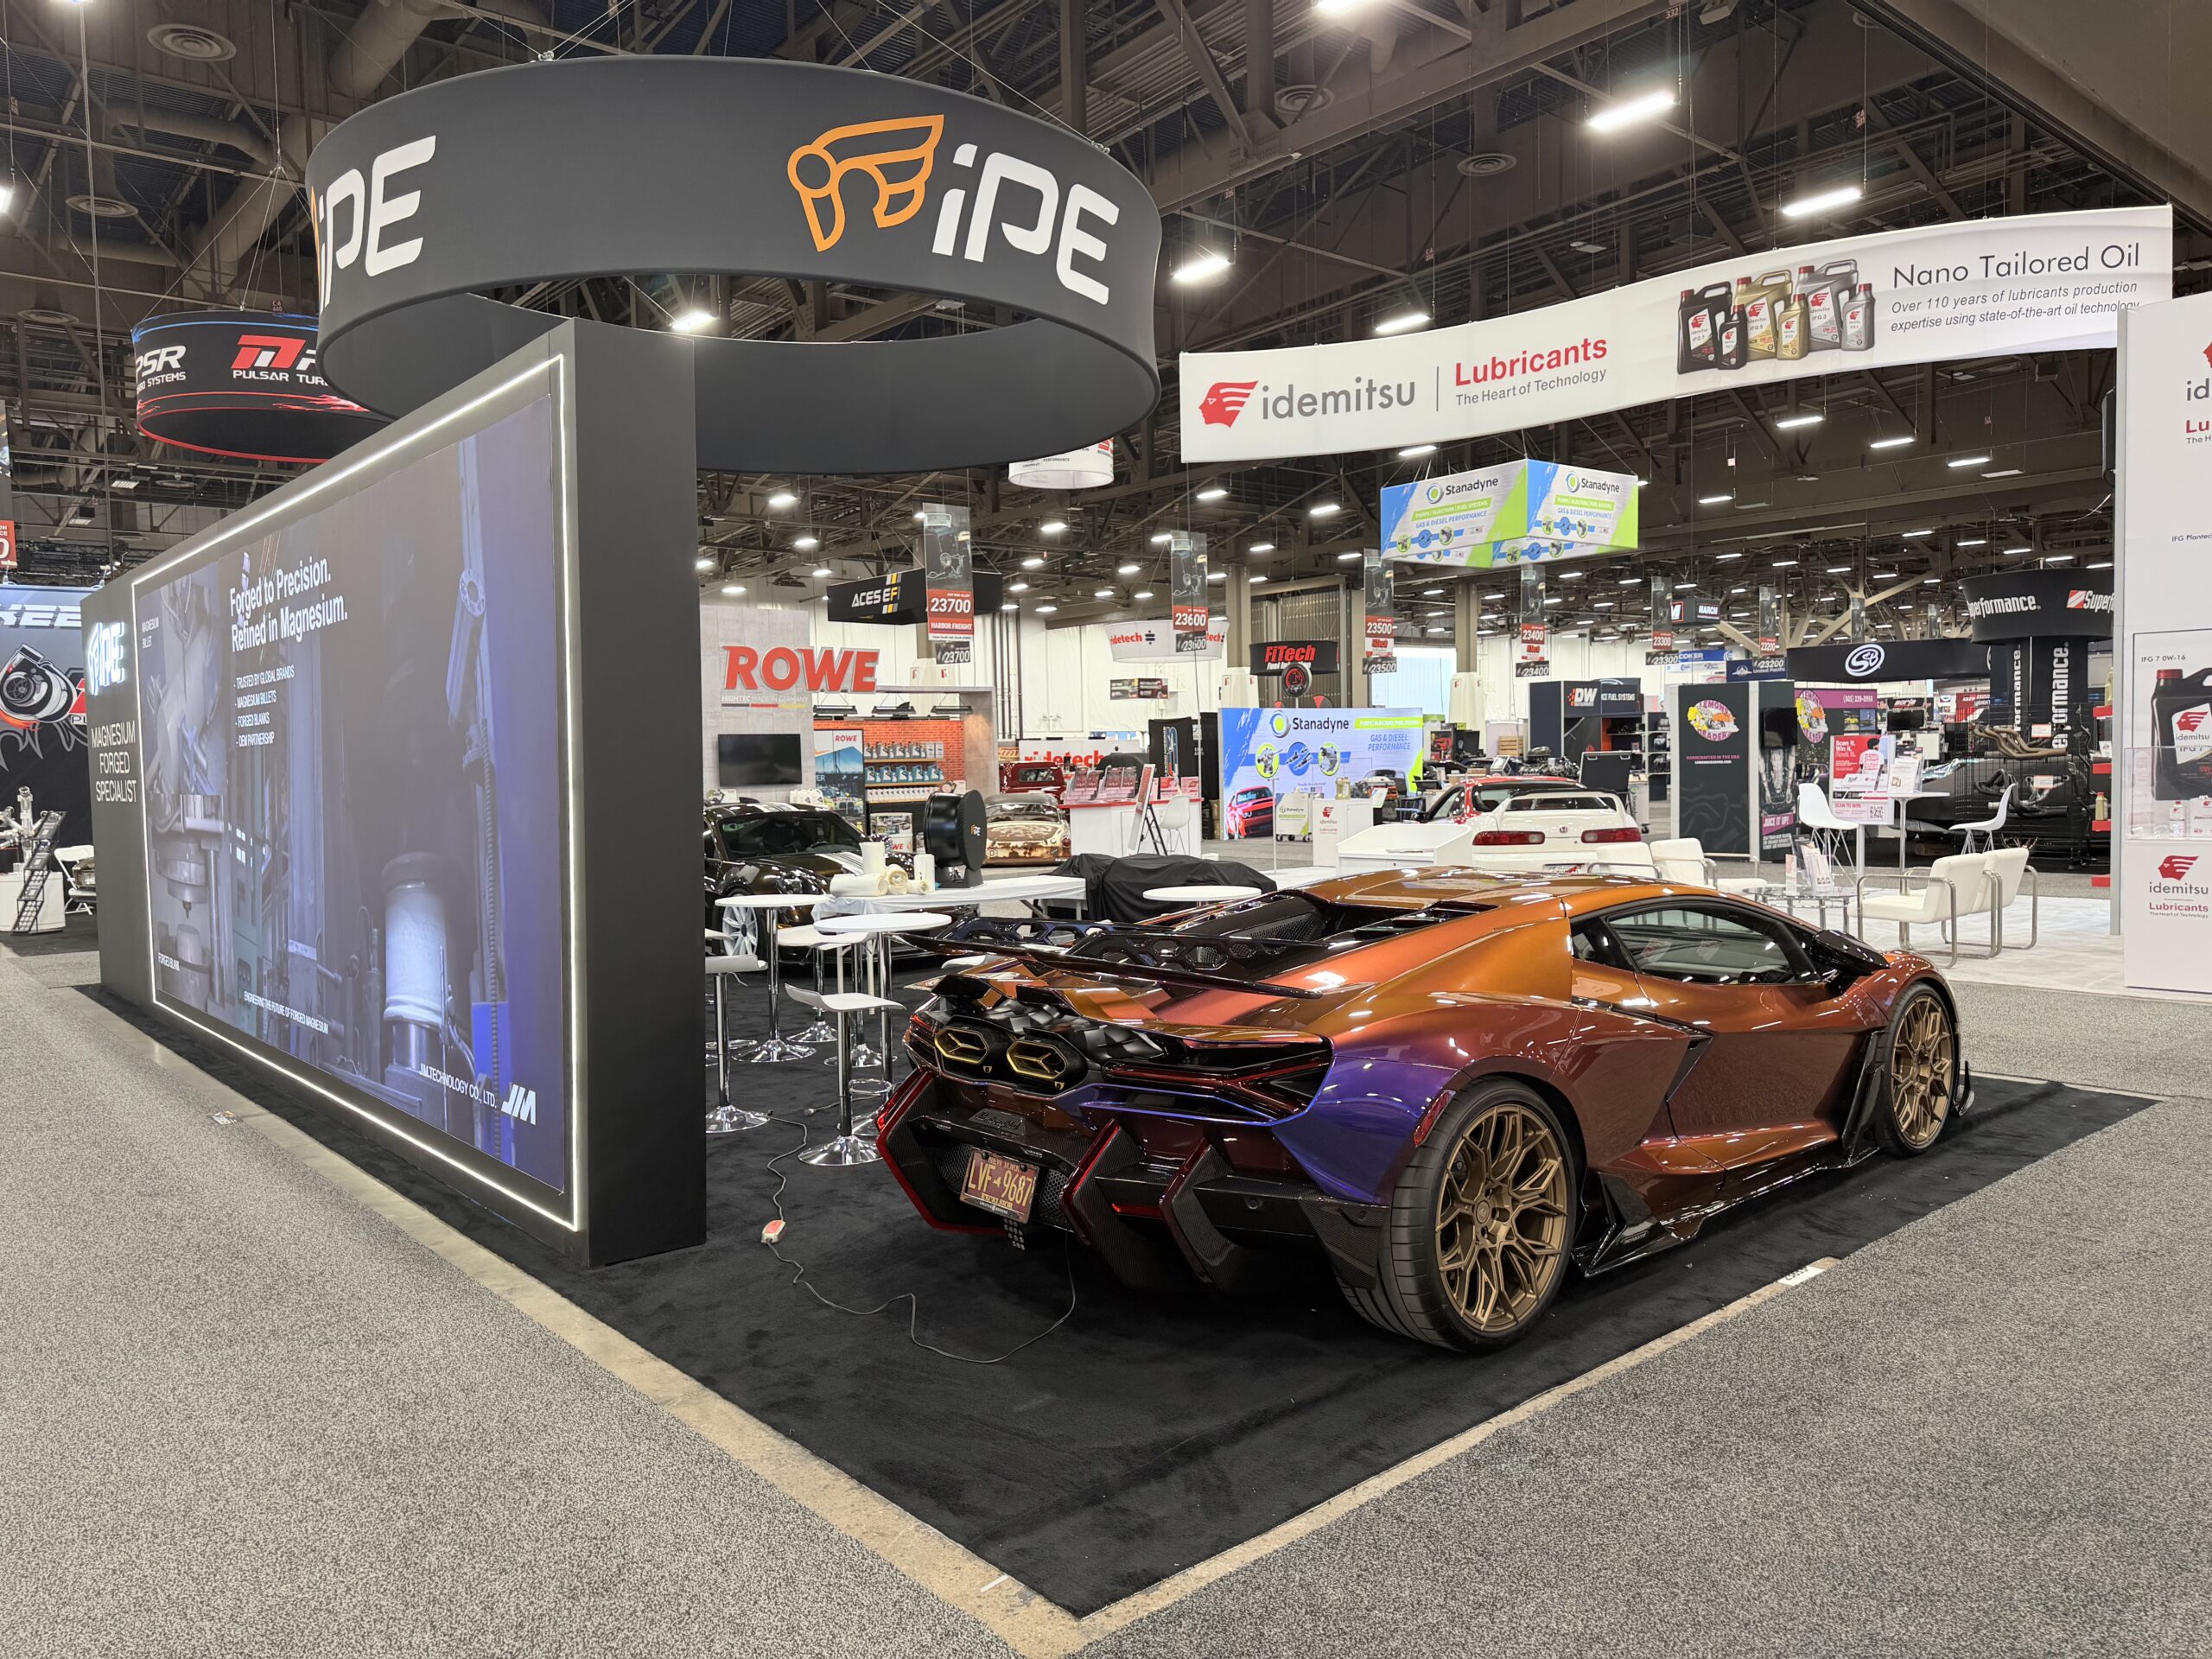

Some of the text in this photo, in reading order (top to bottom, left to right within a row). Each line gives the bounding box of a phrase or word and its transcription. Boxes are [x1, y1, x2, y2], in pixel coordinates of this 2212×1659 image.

[1893, 242, 2139, 289] Nano Tailored Oil
[1891, 281, 2138, 314] Over 110 years of lubricants production
[1891, 315, 1942, 333] expertise
[1945, 313, 1976, 326] using
[1979, 305, 2062, 323] state-of-the-art
[2064, 303, 2076, 315] oil
[1455, 338, 1608, 386] Lubricants
[147, 372, 186, 388] SYSTEMS
[232, 370, 329, 386] PULSAR TUR
[1456, 369, 1606, 405] The Heart of Technology
[1262, 376, 1415, 420] idemitsu
[1446, 477, 1499, 495] Stanadyne
[1581, 478, 1620, 493] Stanadyne
[1431, 518, 1448, 526] DIESEL
[1448, 510, 1487, 524] PERFORMANCE
[230, 556, 331, 620] Forged to Precision.
[851, 589, 881, 607] ACES
[931, 597, 971, 613] 23700
[1699, 605, 1719, 615] MARCH
[232, 594, 347, 652] Refined in Magnesium.
[1175, 613, 1206, 626] 23600
[1366, 622, 1392, 635] 23500
[1522, 630, 1544, 641] 23400
[1653, 637, 1671, 646] 23300
[1760, 642, 1776, 652] 23200
[944, 651, 970, 664] 23700
[1265, 645, 1316, 663] FiTech
[1654, 655, 1679, 664] 23300
[721, 645, 880, 692] ROWE
[1267, 662, 1280, 671] Fuel
[1370, 663, 1396, 673] 23500
[1524, 666, 1549, 677] 23400
[237, 664, 295, 689] TRUSTED BY GLOBAL BRANDS
[237, 690, 276, 709] MAGNESIUM BILLETS
[721, 695, 751, 703] HIGHTEC
[1573, 688, 1598, 702] DW
[238, 711, 270, 728] FORGED BLANKS
[1293, 717, 1350, 734] Stanadyne
[91, 720, 137, 748] MAGNESIUM
[248, 731, 275, 746] PARTNERSHIP
[1370, 734, 1382, 742] GAS
[1388, 733, 1408, 741] DIESEL
[1368, 742, 1411, 752] PERFORMANCE
[99, 751, 130, 774] FORGED
[95, 780, 137, 803] SPECIALIST
[1764, 817, 1776, 828] JUICE
[2149, 881, 2209, 895] idemitsu
[2149, 902, 2209, 912] Lubricants
[290, 1008, 305, 1025] FORGED
[306, 1014, 328, 1034] MAGNESIUM
[483, 1090, 497, 1109] LTD.
[988, 1157, 1020, 1173] NEW YORK
[968, 1160, 1033, 1206] LVF 9687
[981, 1192, 1014, 1210] EXCELSIOR
